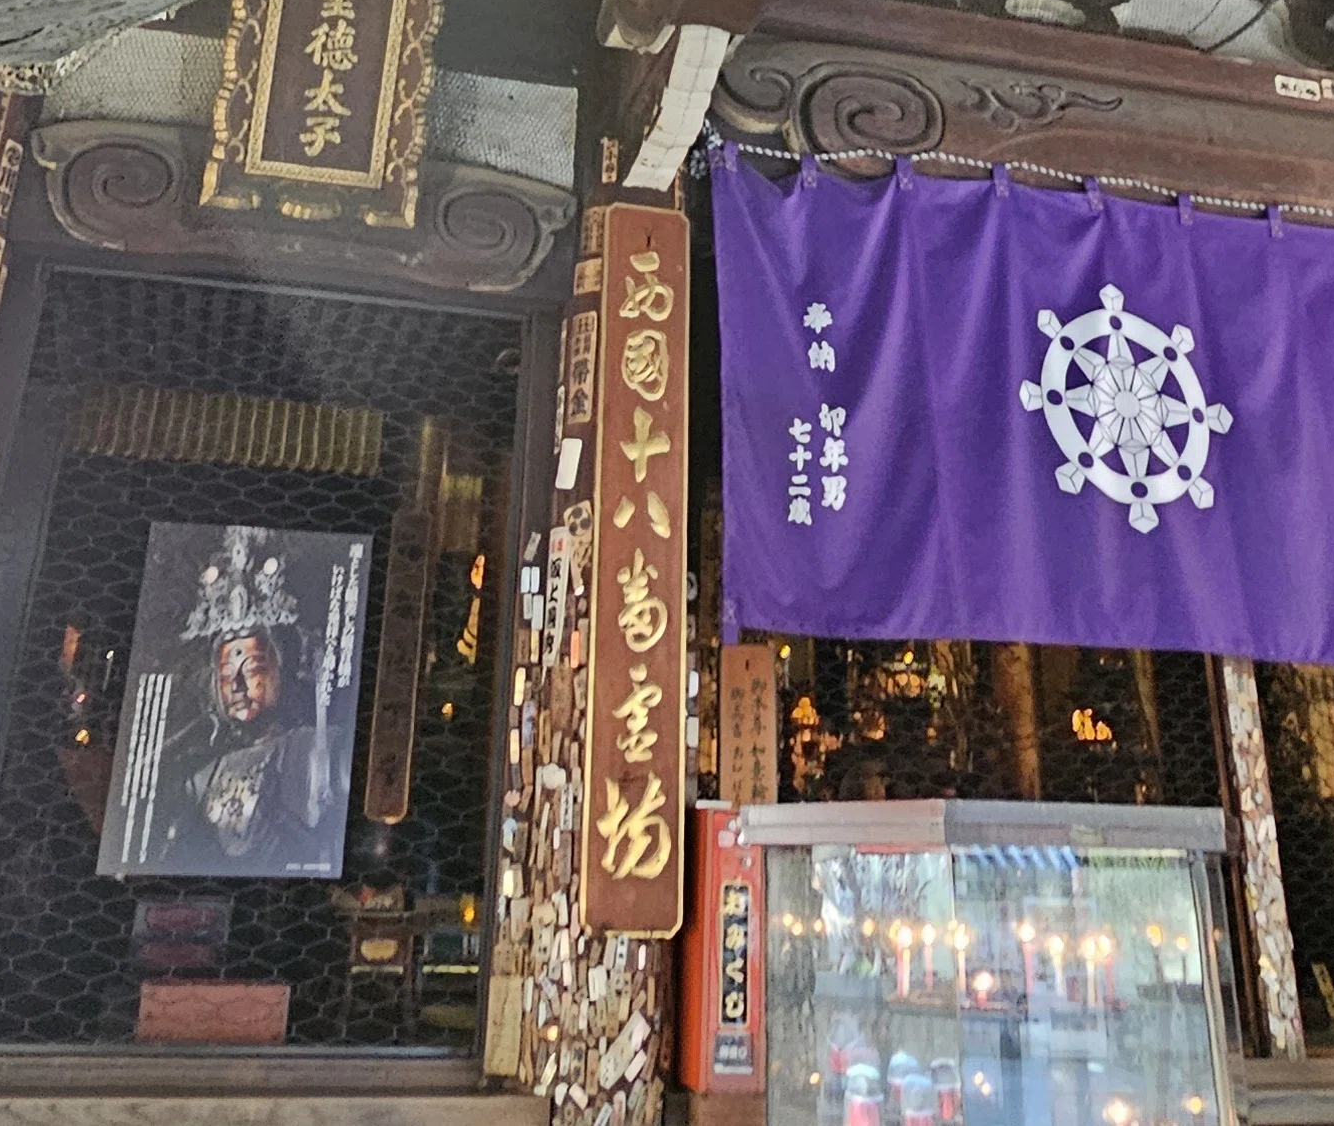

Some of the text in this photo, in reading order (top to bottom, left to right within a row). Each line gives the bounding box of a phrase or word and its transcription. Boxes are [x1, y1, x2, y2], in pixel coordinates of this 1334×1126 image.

[787, 418, 813, 526] 七十二歳
[803, 302, 849, 512] 奉納 卯年男
